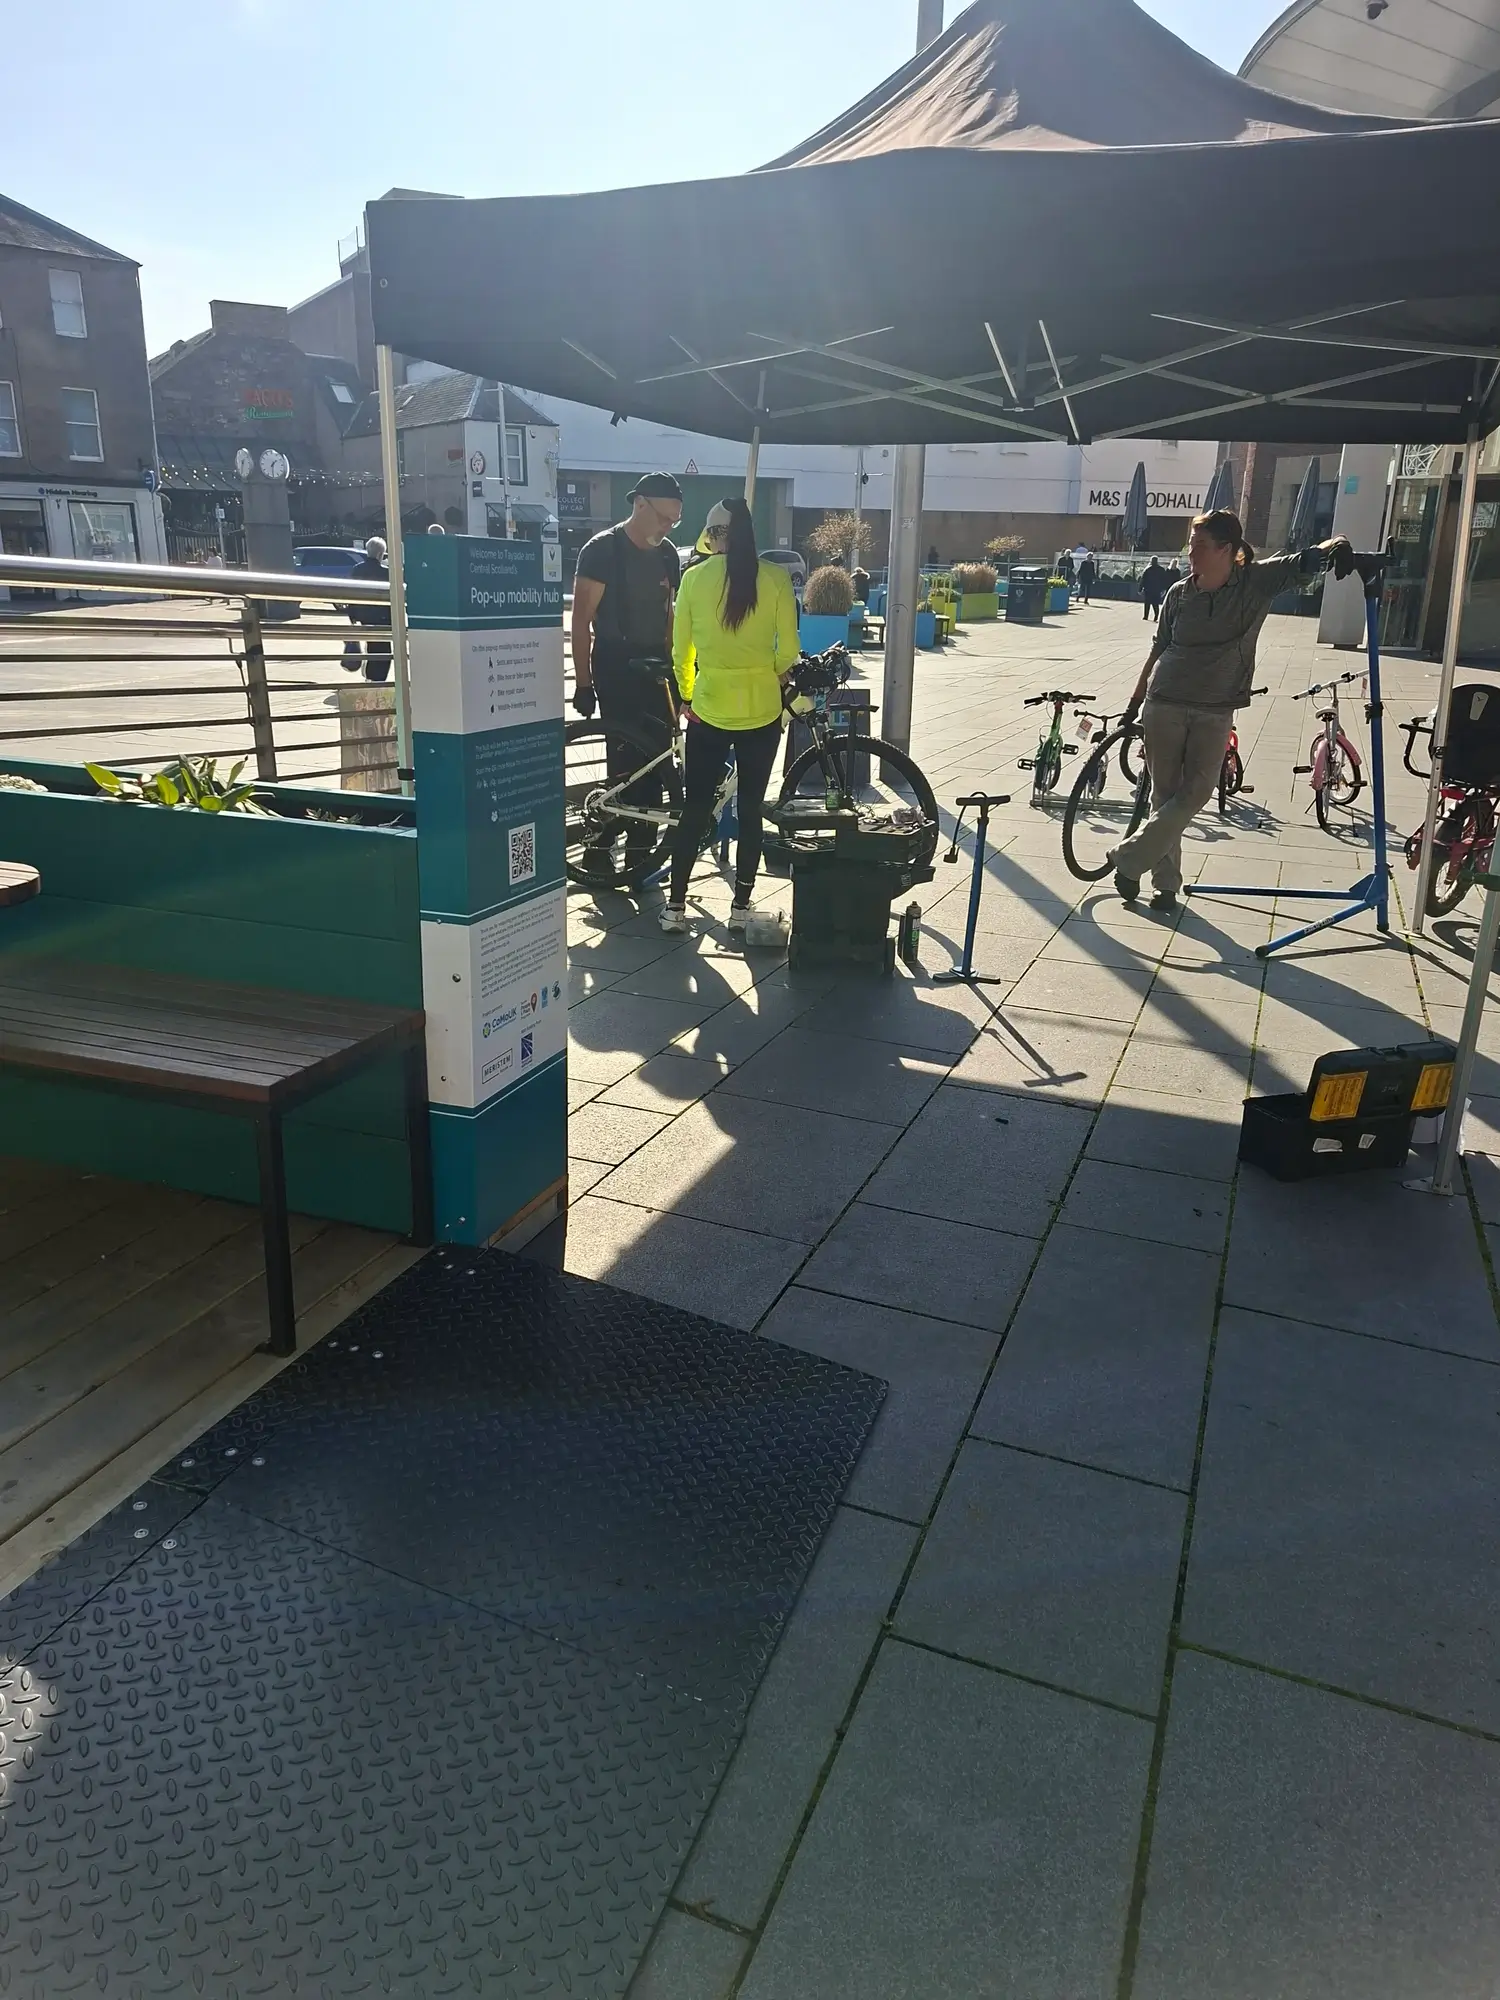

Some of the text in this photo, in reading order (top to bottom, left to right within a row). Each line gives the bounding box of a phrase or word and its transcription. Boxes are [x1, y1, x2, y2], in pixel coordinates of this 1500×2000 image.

[558, 496, 585, 504] COLLECT
[1089, 490, 1203, 509] M&S ODHALL
[470, 548, 497, 560] Welcome
[504, 549, 525, 561] Tayside
[525, 552, 536, 561] and
[470, 562, 490, 575] Central
[471, 587, 560, 608] Pop-up mobility hub
[484, 1054, 511, 1077] MERISTEM
